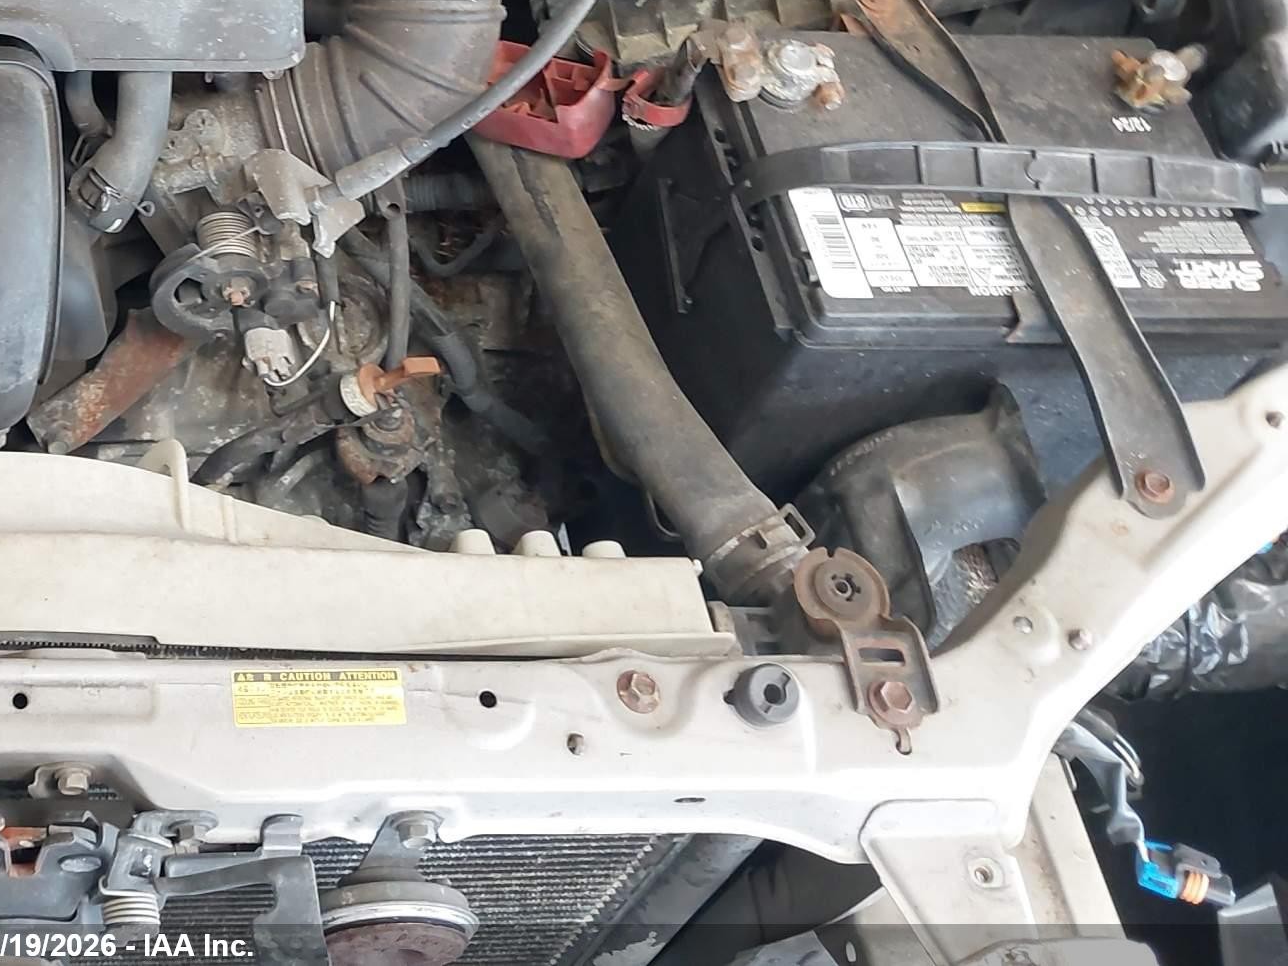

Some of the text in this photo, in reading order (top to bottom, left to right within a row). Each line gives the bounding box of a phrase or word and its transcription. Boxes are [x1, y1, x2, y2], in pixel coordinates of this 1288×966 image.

[1176, 270, 1261, 292] SUPER
[280, 671, 331, 682] CAUTION
[339, 671, 395, 681] ATTENTION
